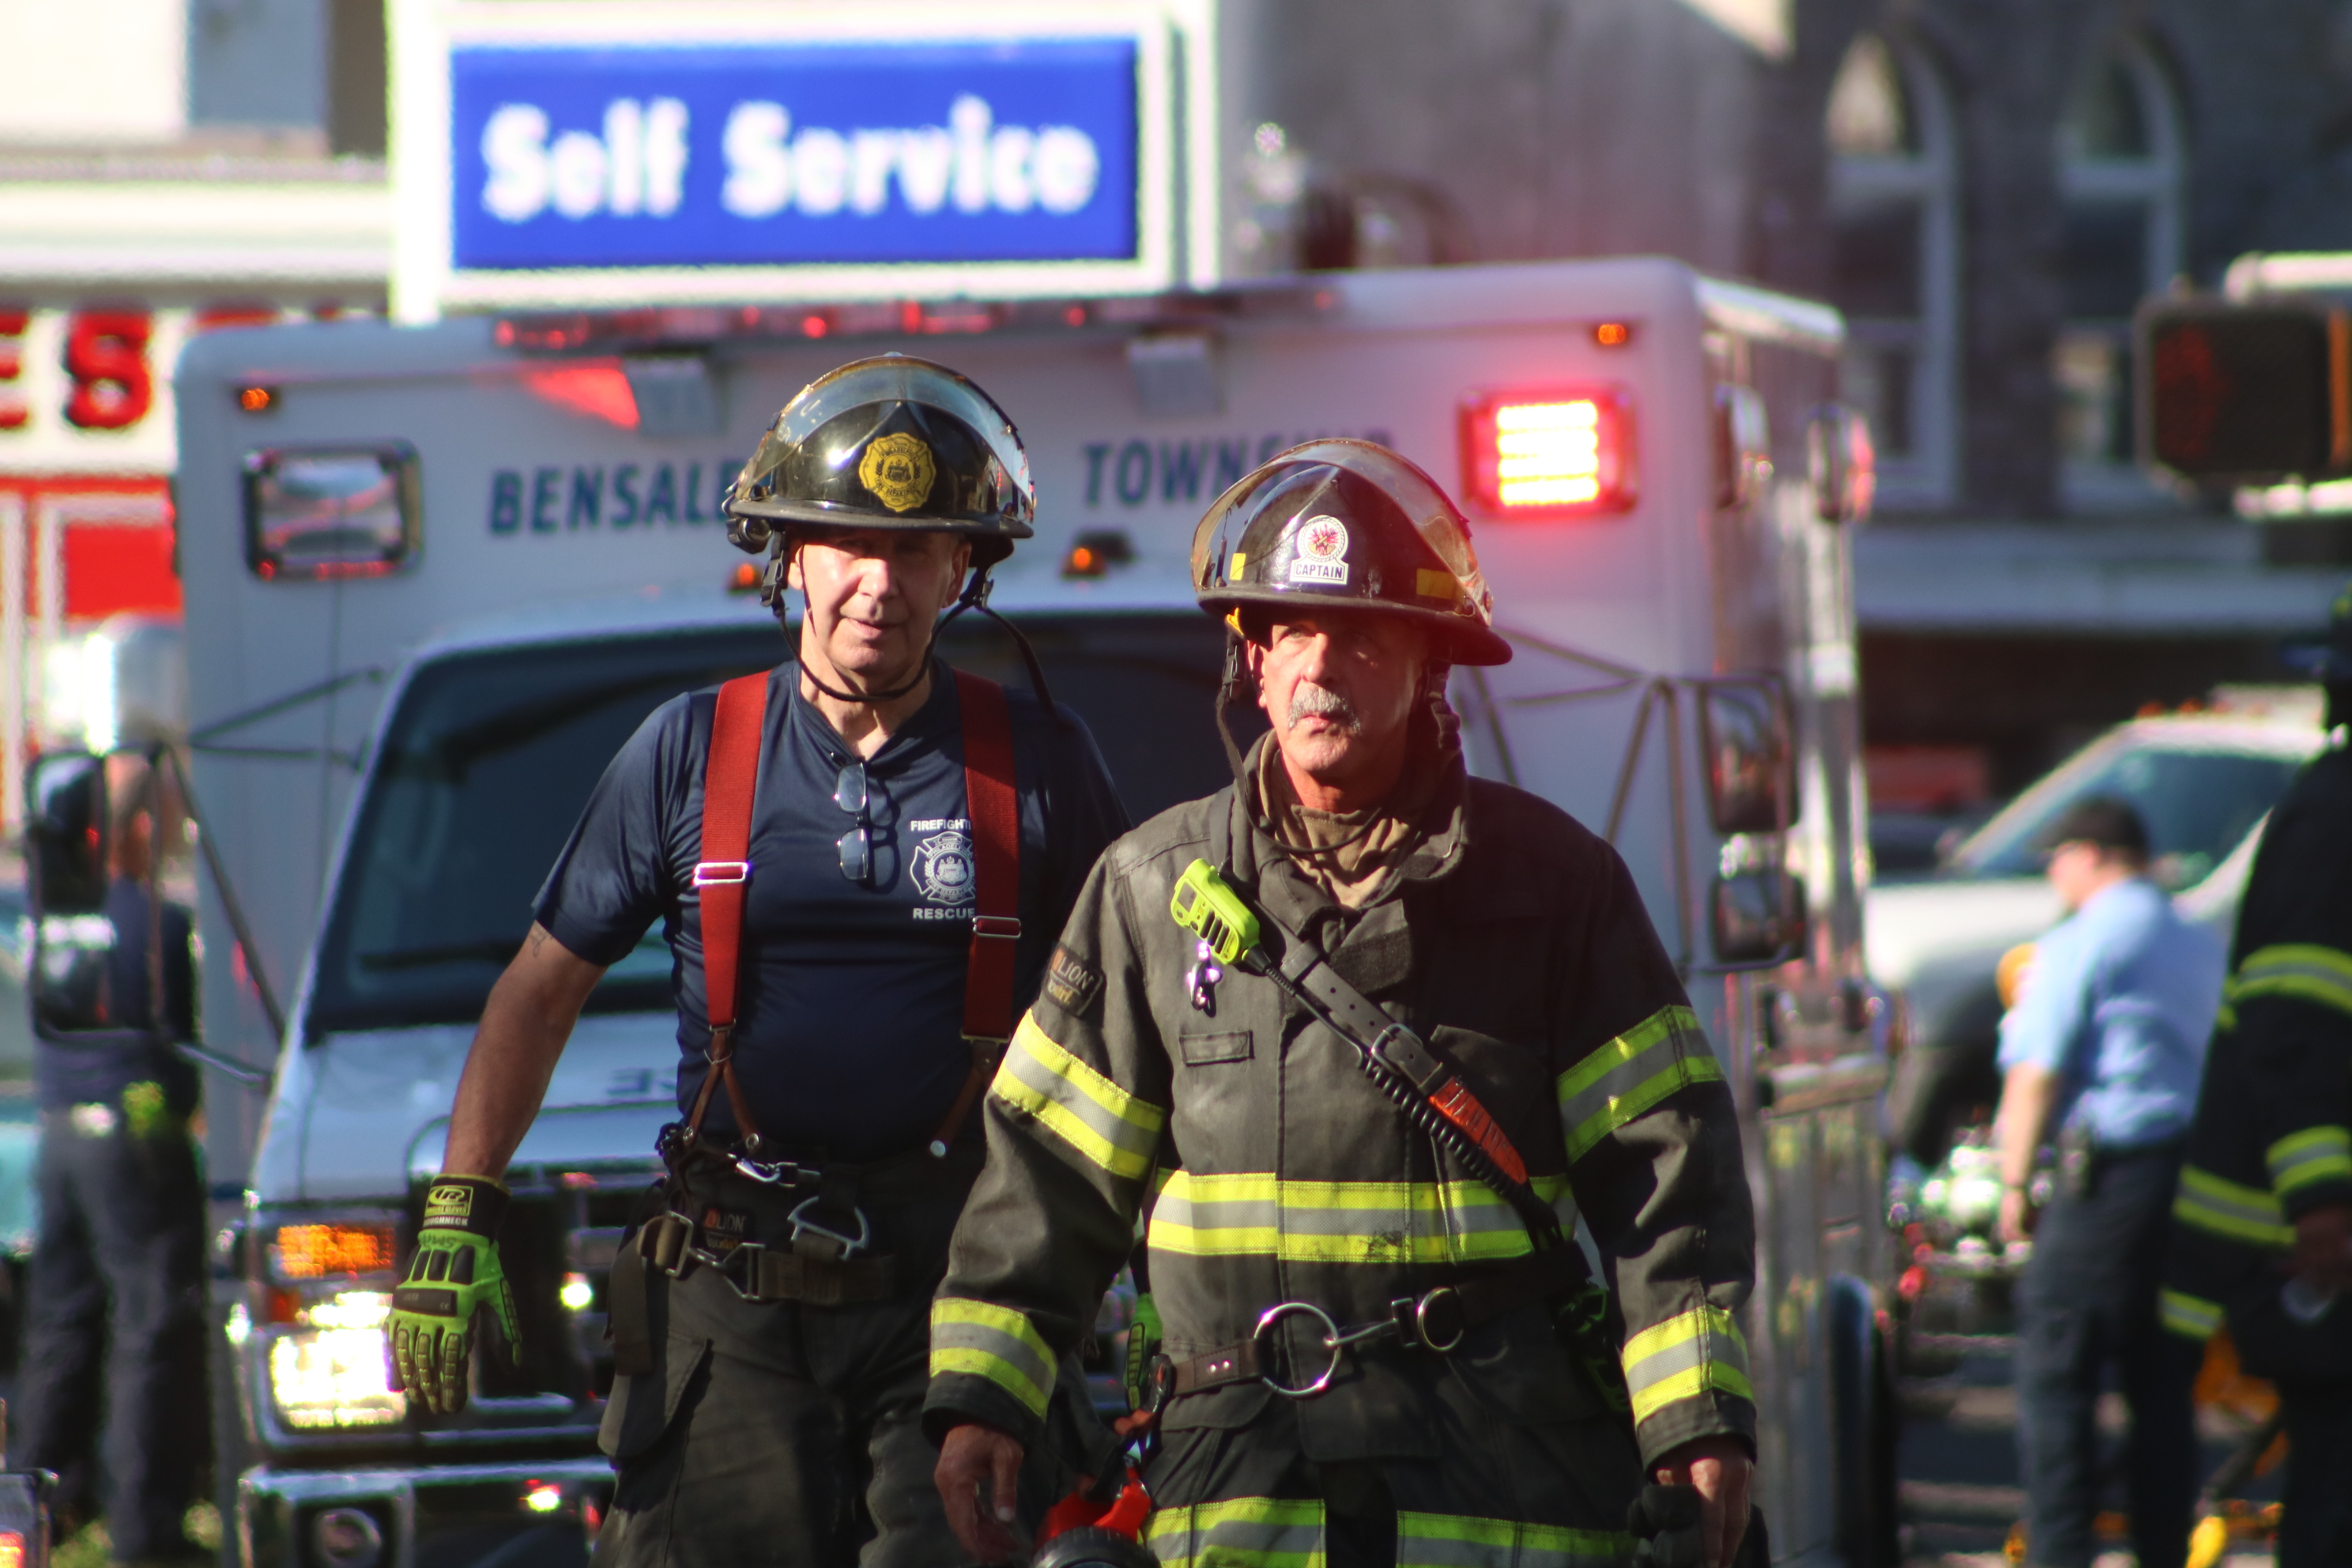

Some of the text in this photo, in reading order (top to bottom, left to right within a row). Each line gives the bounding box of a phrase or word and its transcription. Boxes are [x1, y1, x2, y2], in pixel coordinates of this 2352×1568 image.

[481, 93, 1099, 224] Self Service
[1295, 564, 1343, 579] CAPTAIN
[910, 819, 971, 831] FIREFIGHT
[913, 907, 975, 919] RESCUE
[1057, 956, 1095, 990] LION
[715, 1214, 747, 1232] LION
